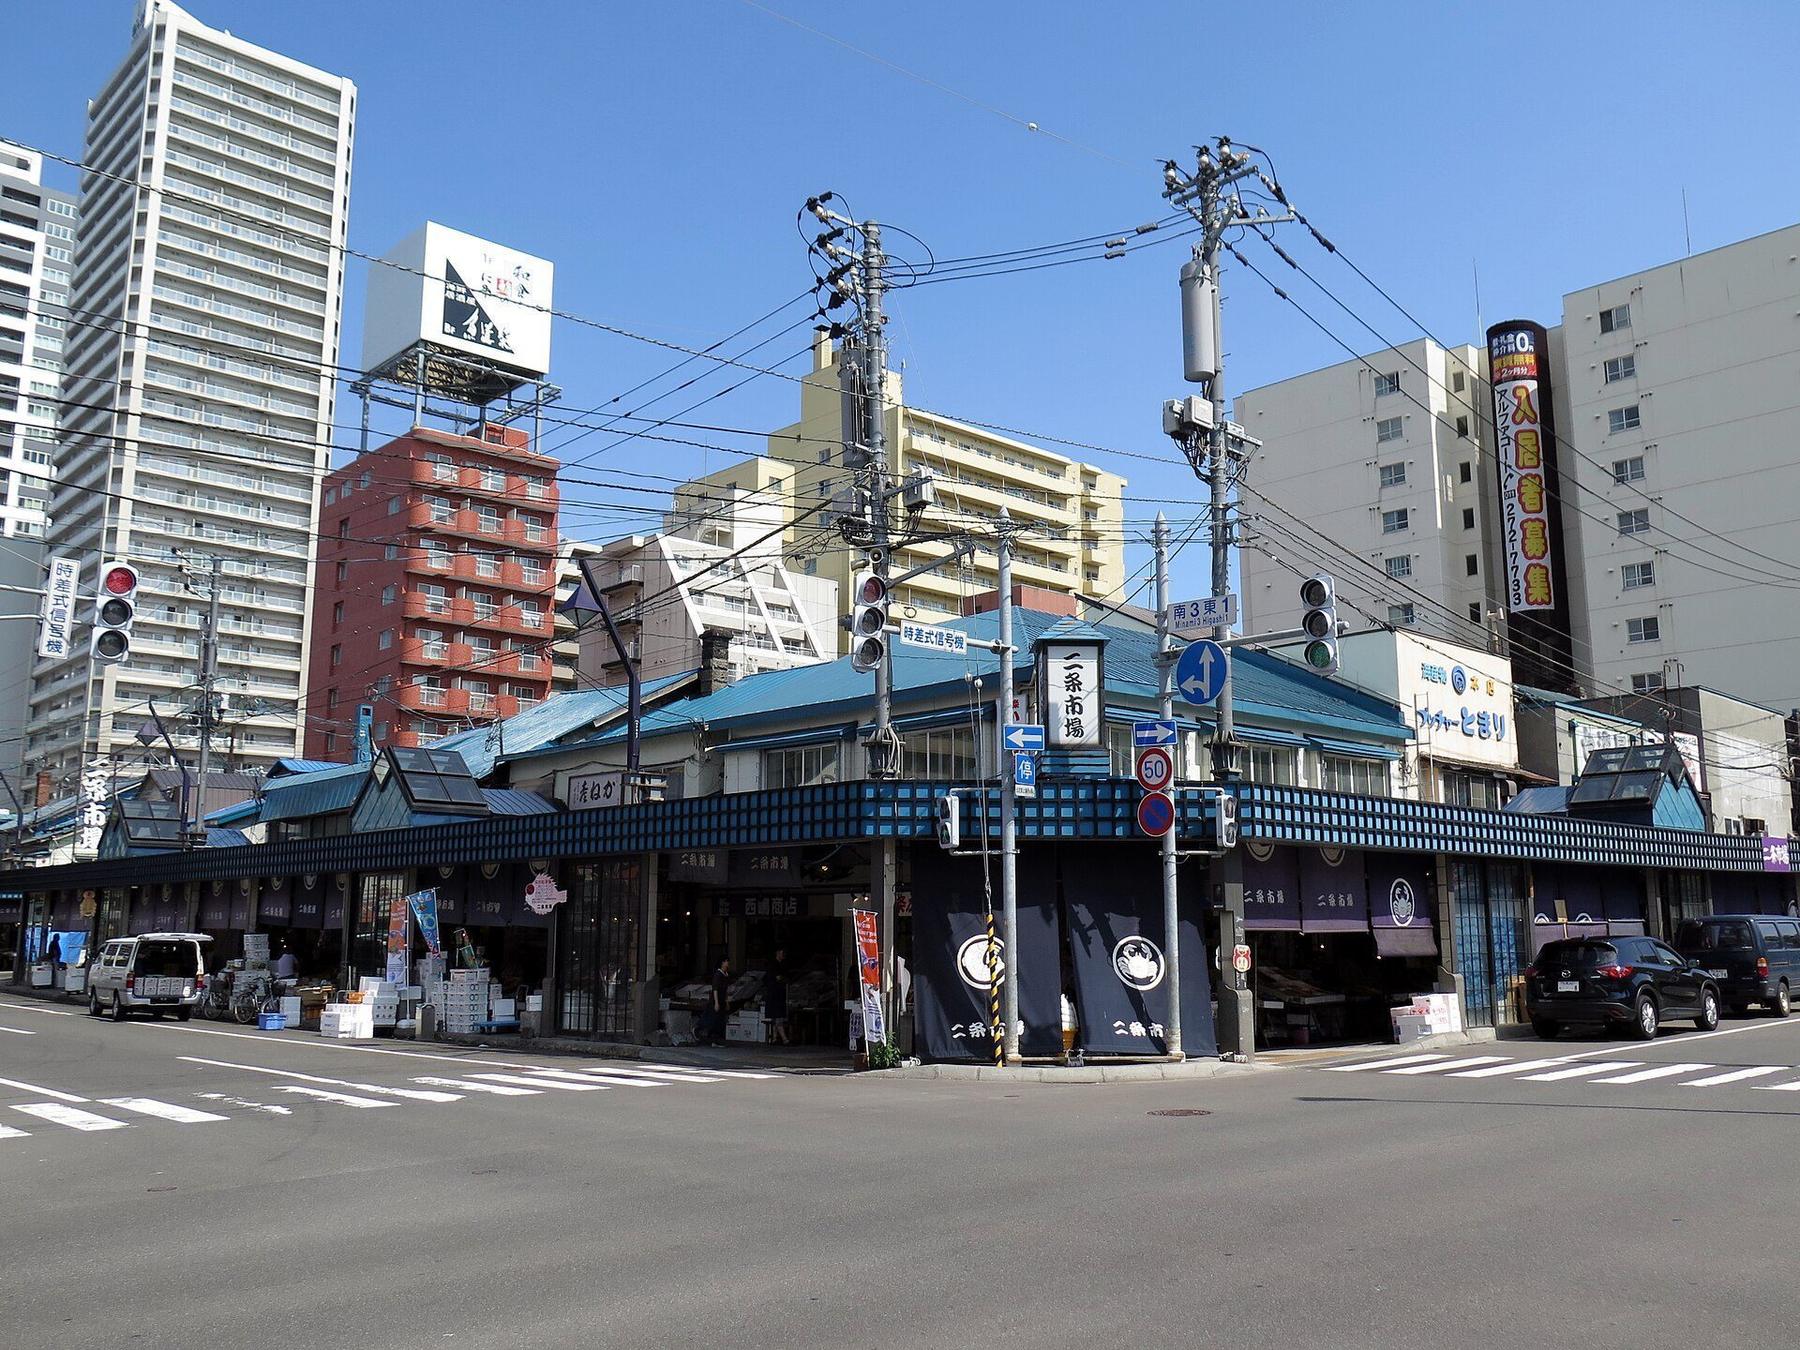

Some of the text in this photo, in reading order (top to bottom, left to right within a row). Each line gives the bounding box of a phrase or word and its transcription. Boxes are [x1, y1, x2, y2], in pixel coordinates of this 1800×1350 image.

[1512, 385, 1551, 605] 入居者募集
[1506, 503, 1521, 606] 272-7733
[46, 562, 73, 654] 時差式信号機
[904, 626, 964, 650] 時差式信号機
[1063, 653, 1085, 739] 二条市場
[1019, 760, 1032, 779] 停
[1144, 760, 1164, 778] 50
[80, 758, 109, 849] 二条市場
[1763, 845, 1789, 864] 二条市場
[1244, 890, 1284, 904] 二条市場
[1318, 894, 1353, 907] 二条市場
[1113, 1021, 1164, 1037] 二条市
